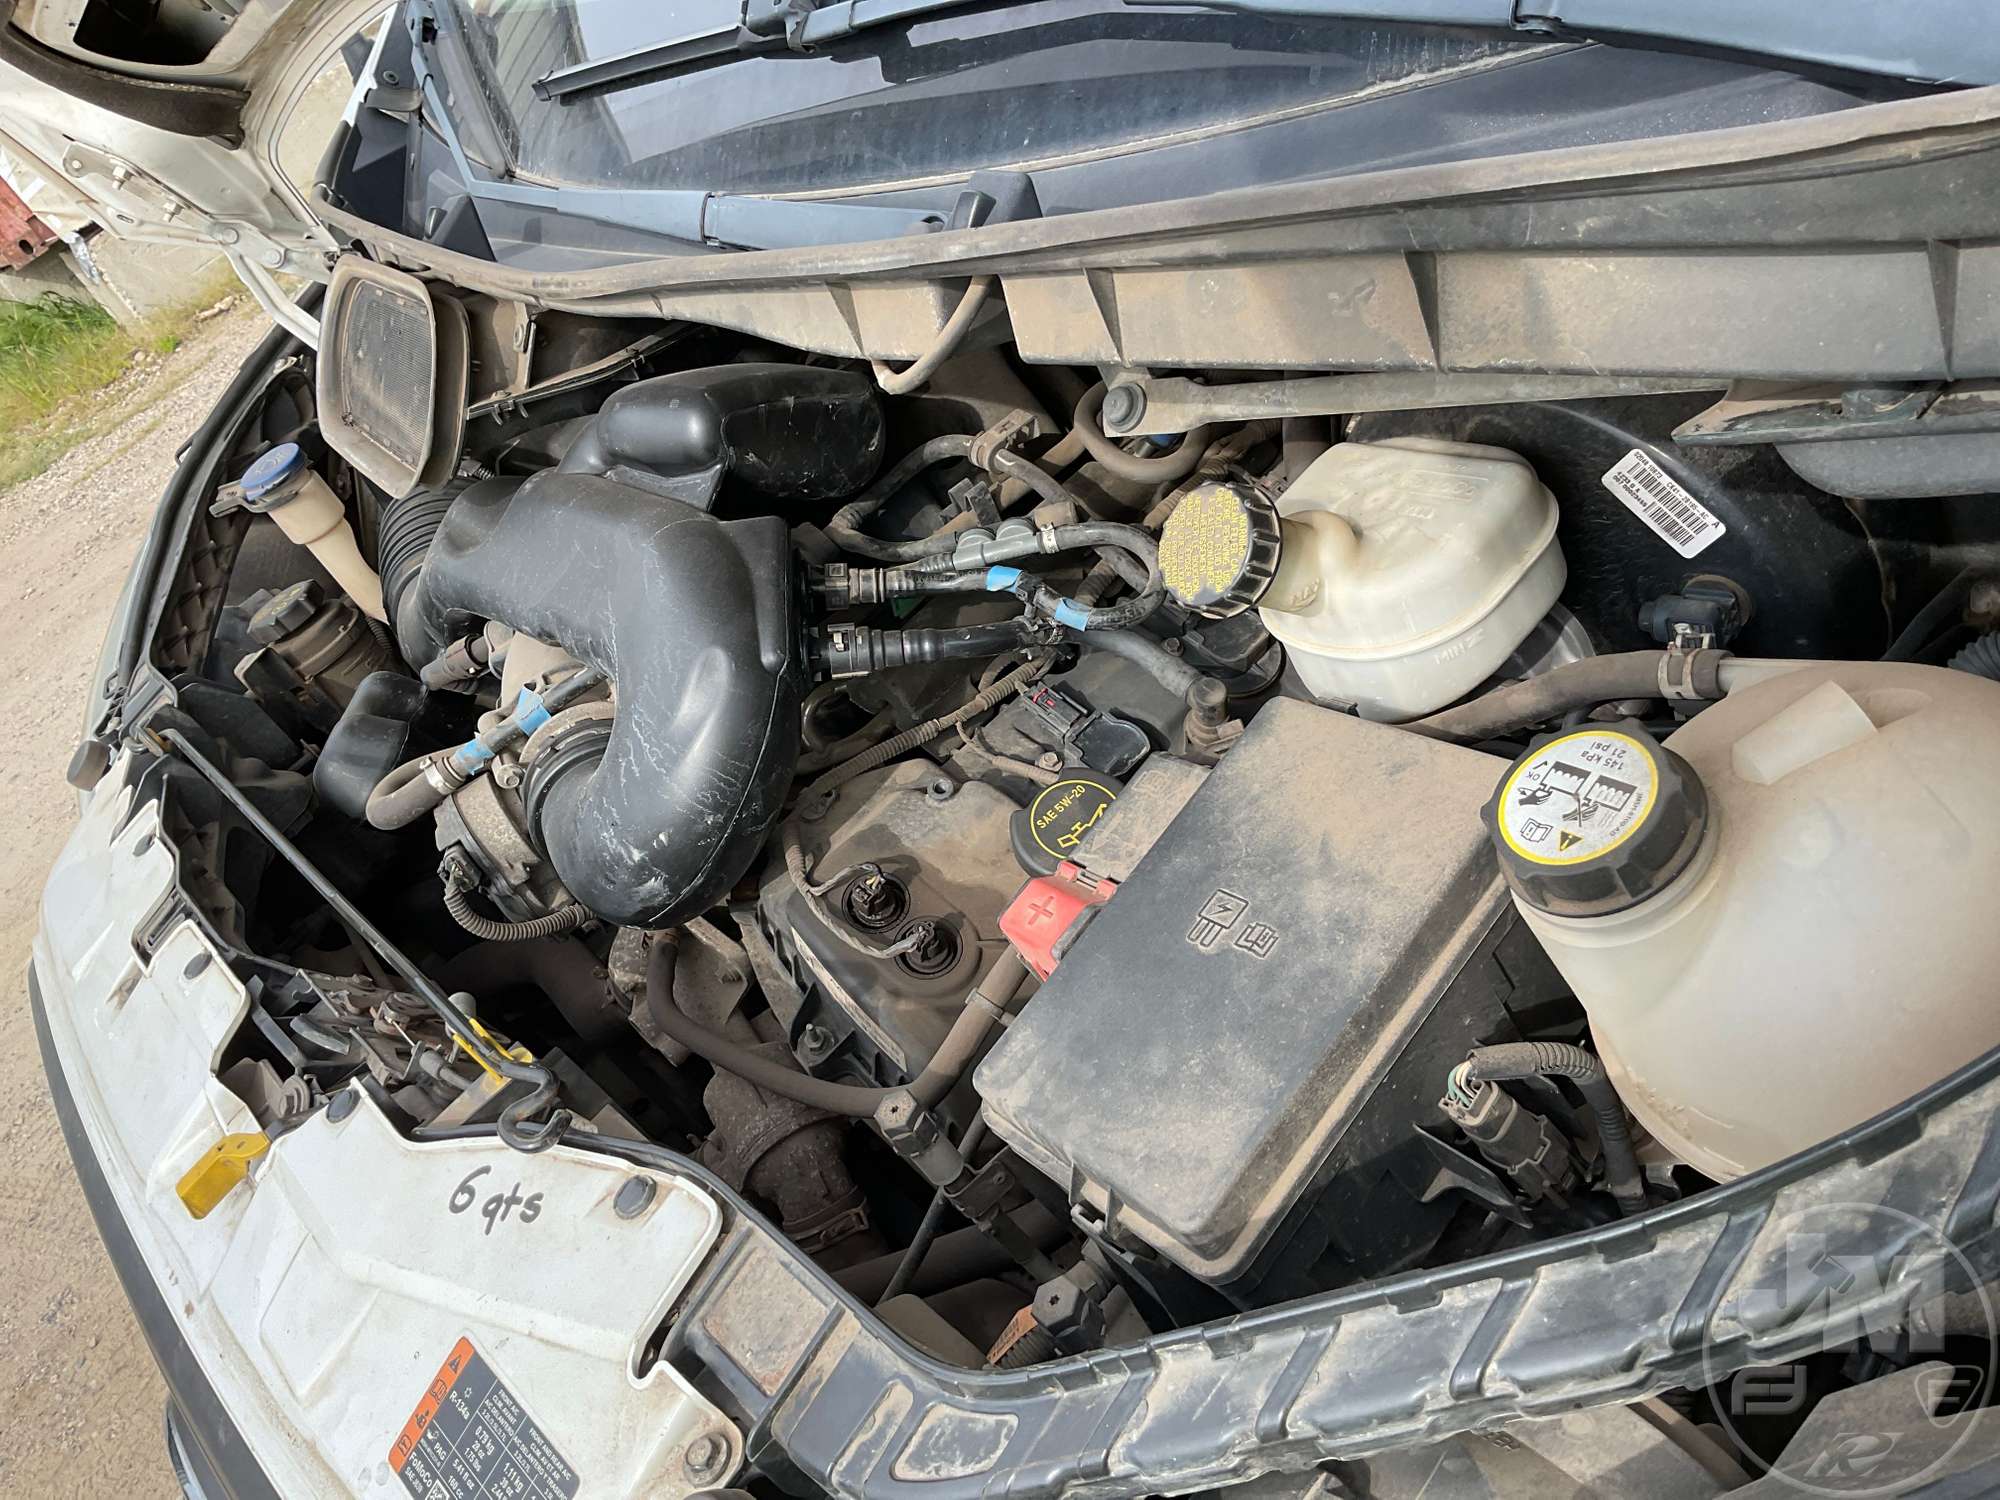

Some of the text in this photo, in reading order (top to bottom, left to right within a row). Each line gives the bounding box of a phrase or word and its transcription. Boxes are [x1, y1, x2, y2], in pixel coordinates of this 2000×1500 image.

[1591, 741, 1611, 753] psi
[1603, 758, 1624, 770] 145
[1036, 784, 1085, 829] SAE 5W-20
[449, 1164, 544, 1236] 6 qts
[448, 1389, 471, 1420] R-134a
[433, 1442, 446, 1460] PAG
[477, 1449, 485, 1459] oz
[483, 1439, 495, 1456] kg
[407, 1451, 435, 1488] FoMoCo
[502, 1461, 524, 1493] 1.11 kg
[466, 1478, 475, 1490] oz
[505, 1486, 513, 1498] oz
[455, 1487, 463, 1499] cc
